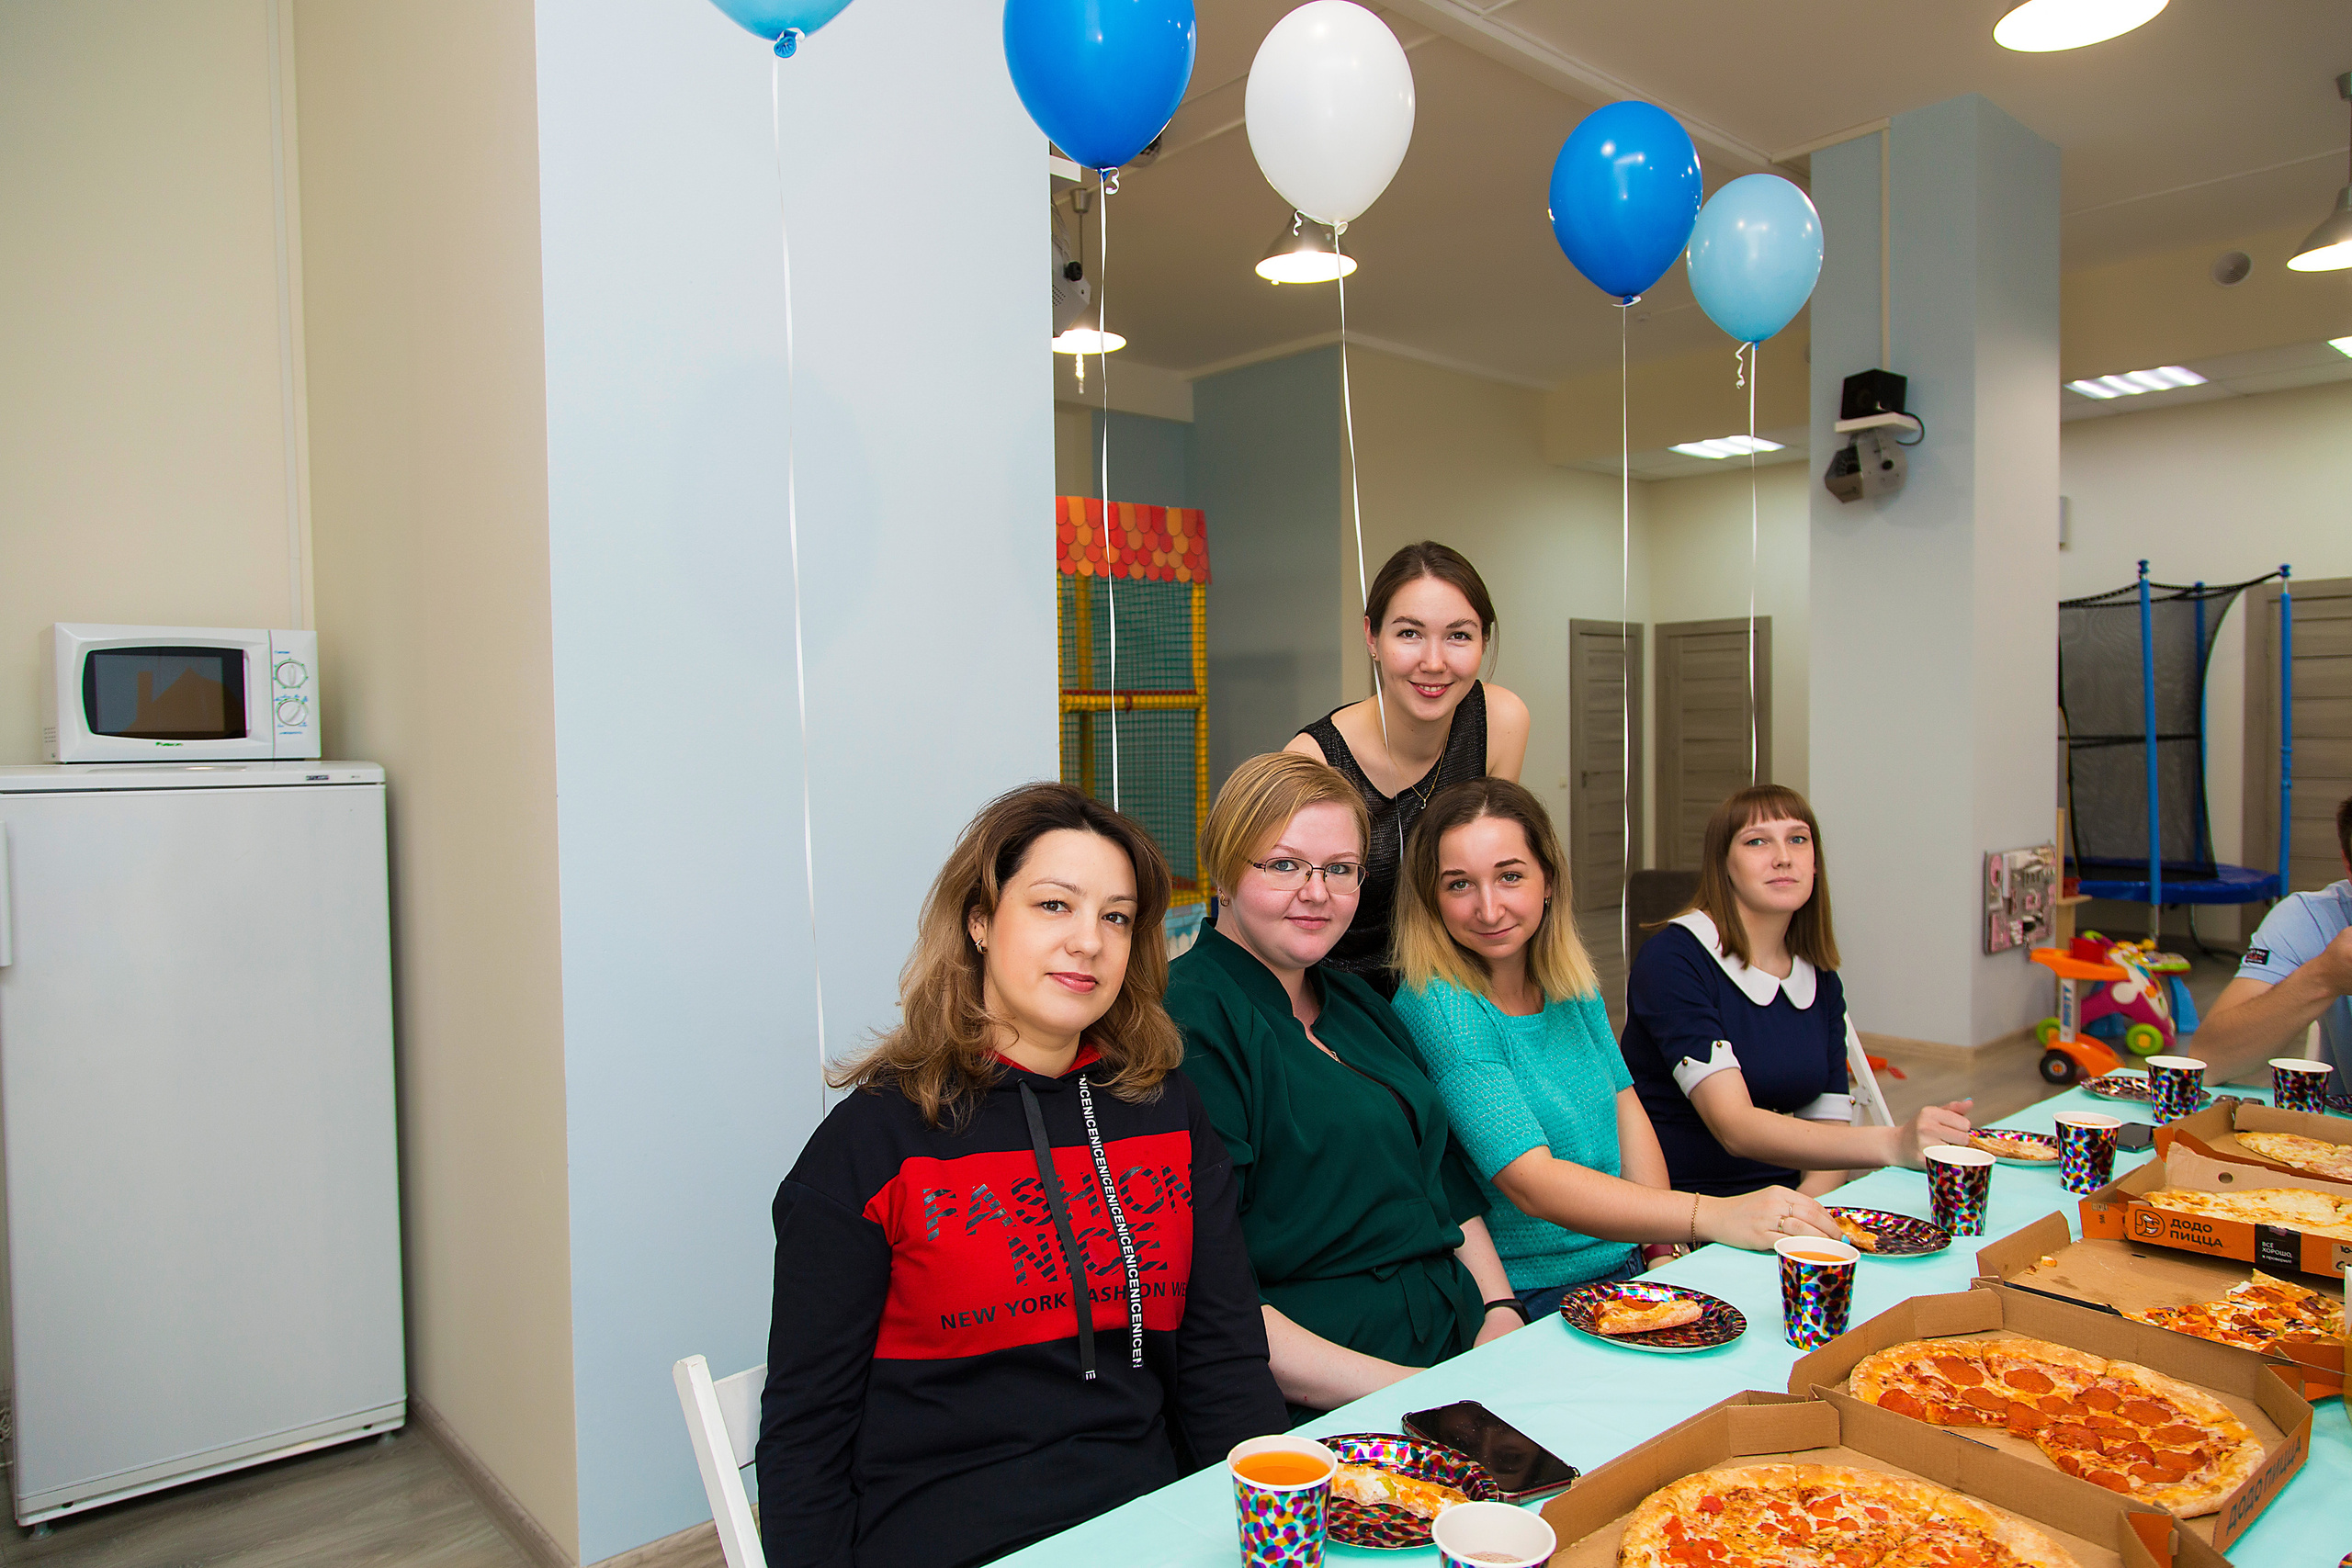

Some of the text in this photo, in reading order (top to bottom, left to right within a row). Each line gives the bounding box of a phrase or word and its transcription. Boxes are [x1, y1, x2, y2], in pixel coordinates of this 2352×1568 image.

[922, 1164, 1193, 1242] FASHON
[2170, 1218, 2213, 1234] ДОДО
[2170, 1231, 2223, 1247] ПИЦЦА
[940, 1305, 996, 1330] NEW
[1004, 1292, 1068, 1317] YORK
[1075, 1281, 1166, 1304] ASHON
[2226, 1436, 2301, 1536] ДОДО ПИЦЦА
